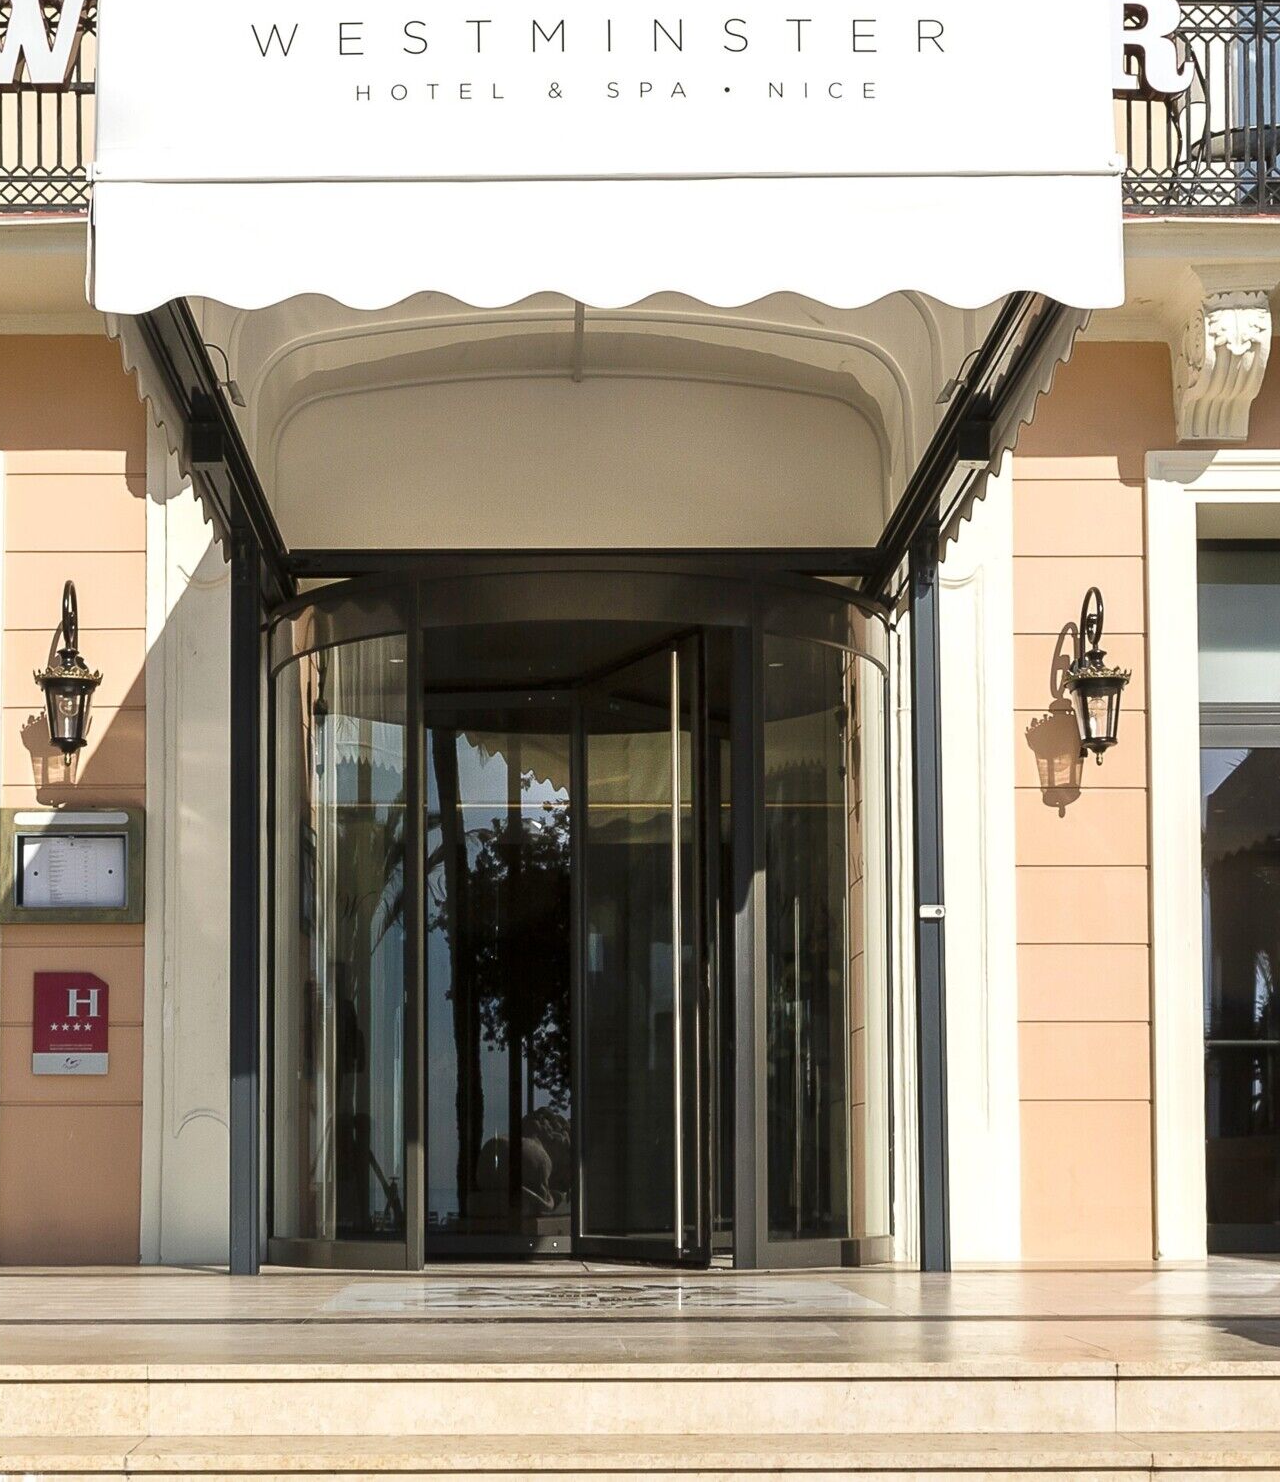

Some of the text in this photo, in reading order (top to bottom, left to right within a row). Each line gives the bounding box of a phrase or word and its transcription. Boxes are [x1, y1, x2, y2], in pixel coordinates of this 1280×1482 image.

[250, 17, 946, 59] WESTMINSTER
[355, 81, 876, 102] HOTEL & SPA NICE
[65, 988, 102, 1018] H
